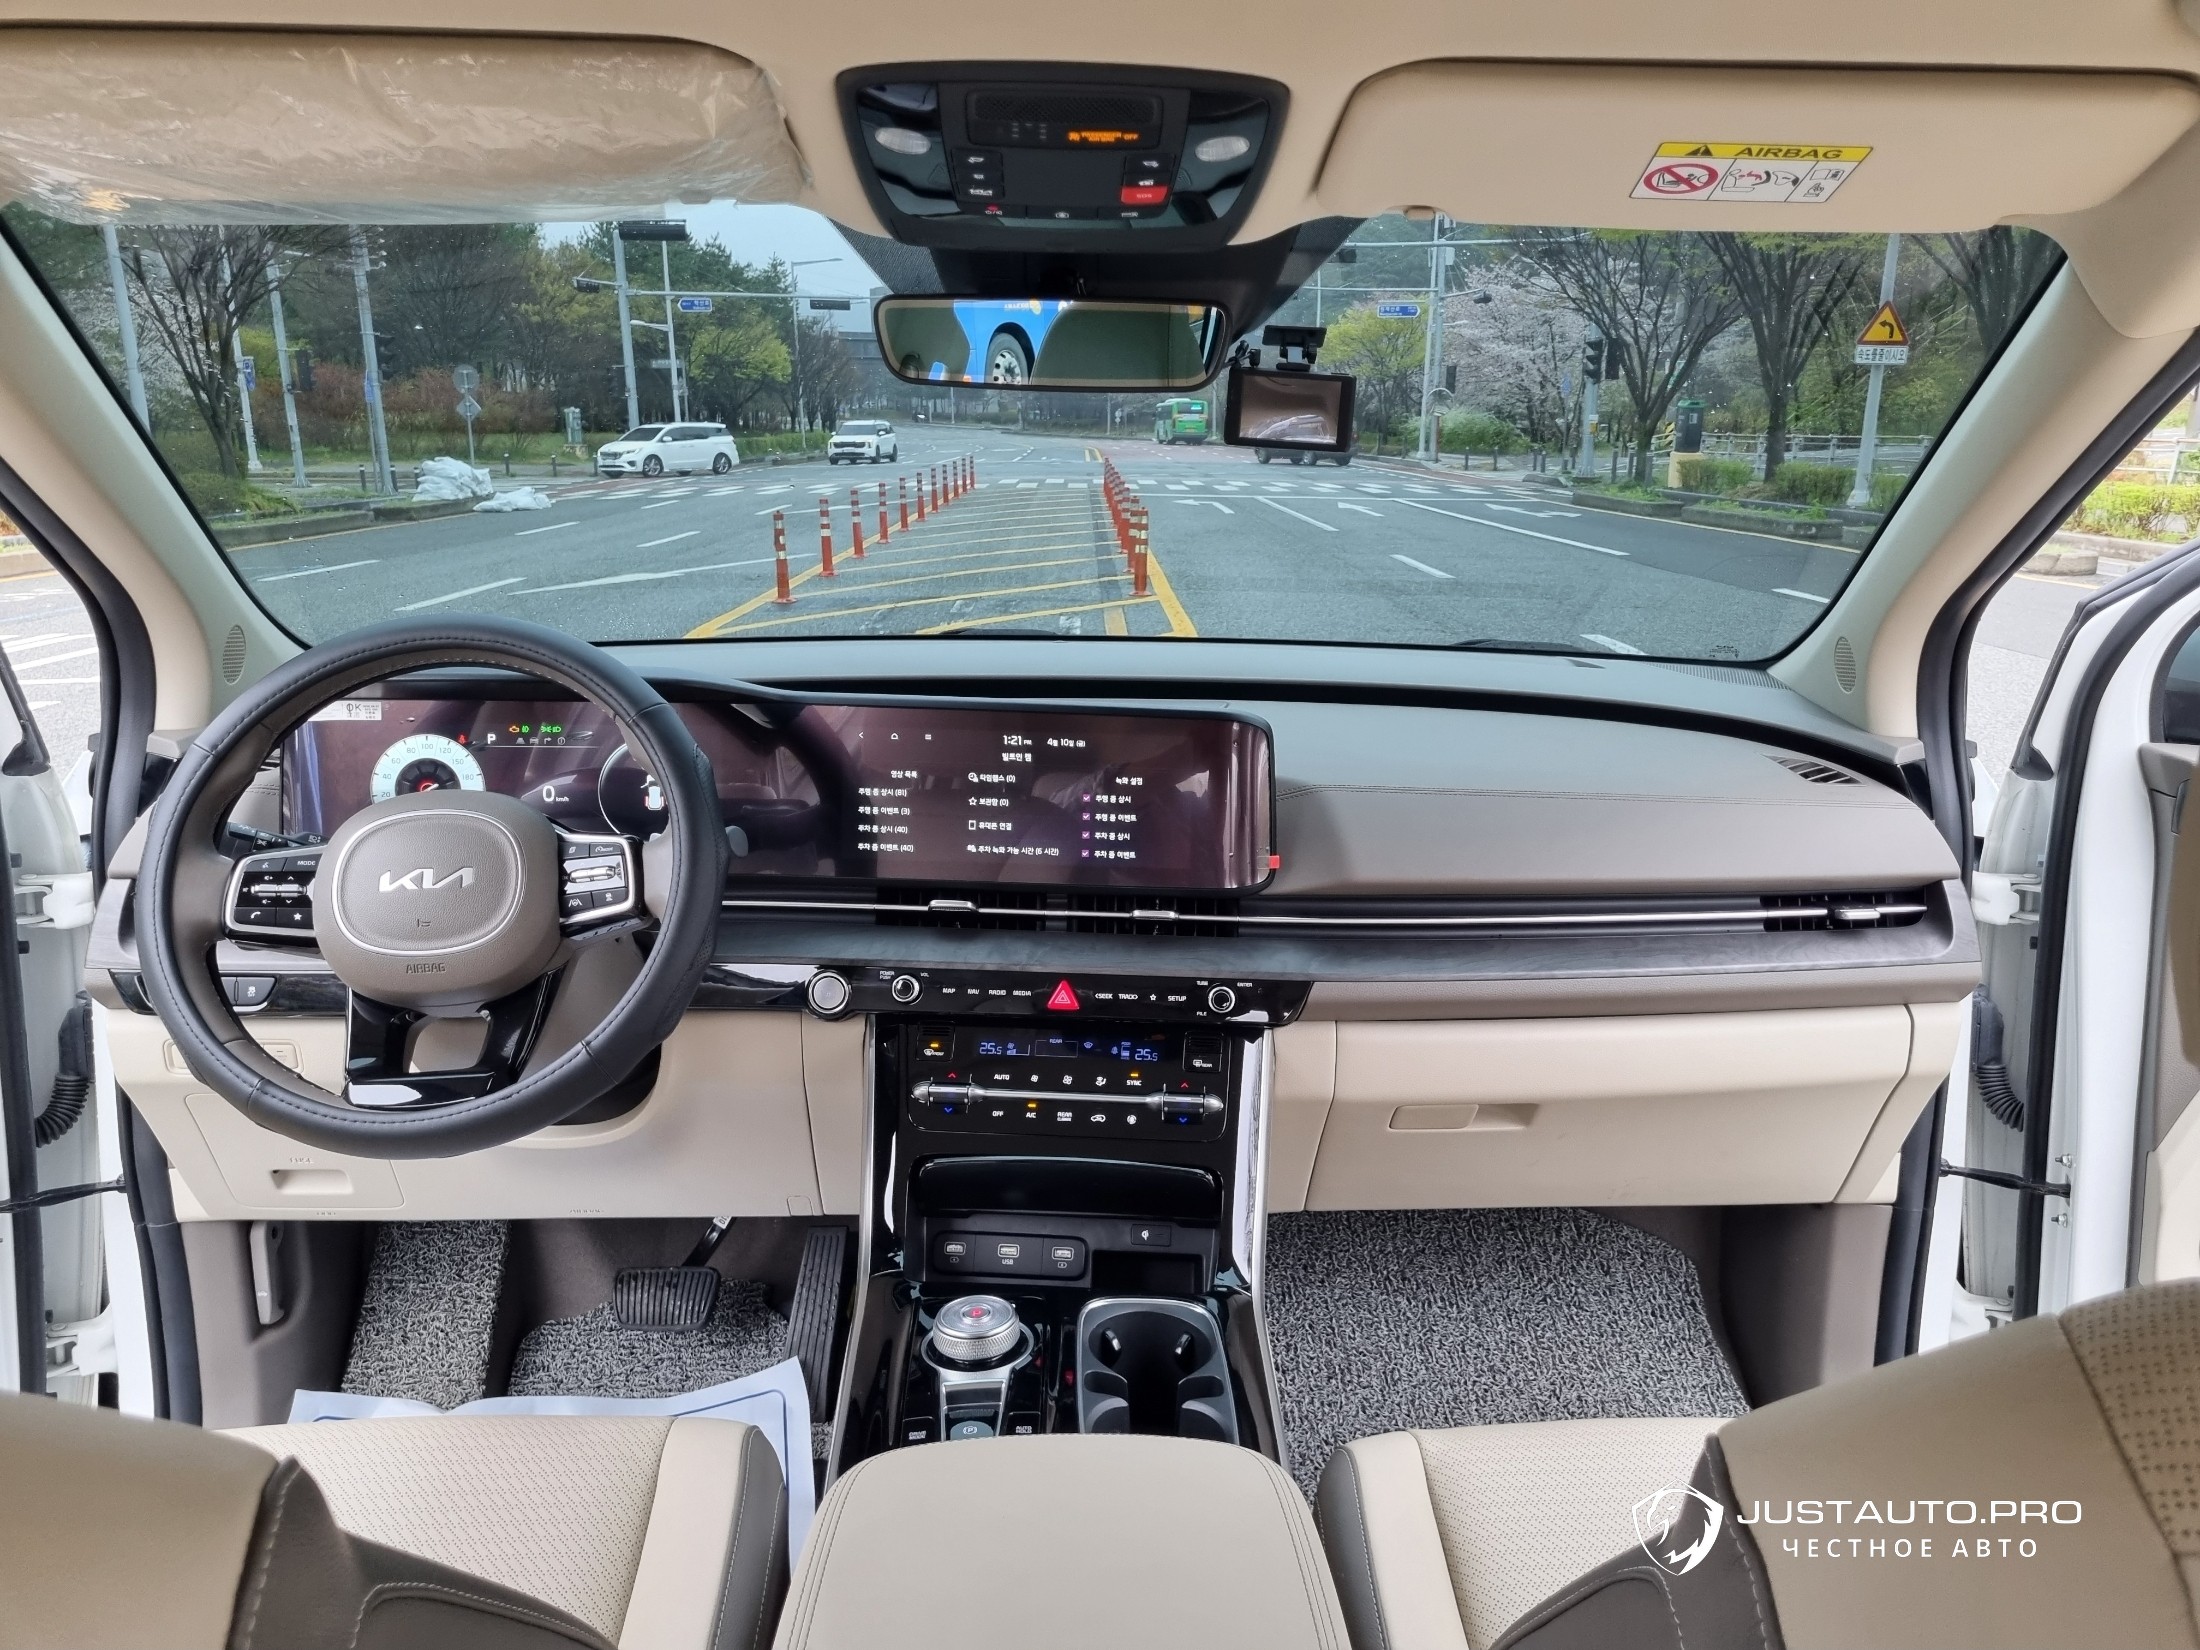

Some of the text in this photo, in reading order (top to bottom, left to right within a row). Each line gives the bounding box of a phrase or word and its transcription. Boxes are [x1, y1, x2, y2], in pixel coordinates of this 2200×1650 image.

[1734, 147, 1844, 159] AIRBAG
[1858, 348, 1904, 361] 속도를줄이시오
[487, 734, 496, 744] P
[1003, 735, 1022, 746] 1:21
[1002, 752, 1032, 762] 빌트인 캠
[1006, 775, 1015, 783] (0)
[543, 786, 555, 801] 0
[881, 788, 894, 796] 상시
[1000, 799, 1009, 807] (0)
[881, 807, 899, 815] 이벤트
[858, 825, 870, 833] 주차
[880, 844, 899, 852] 이벤트
[900, 844, 914, 852] (40)
[978, 846, 991, 854] 주차
[1007, 847, 1019, 855] 가능
[1044, 848, 1059, 856] 시간)
[379, 867, 473, 891] KIA
[406, 963, 446, 974] AIRBAG
[980, 1042, 1002, 1054] 25.5
[1135, 1048, 1158, 1061] 25.5
